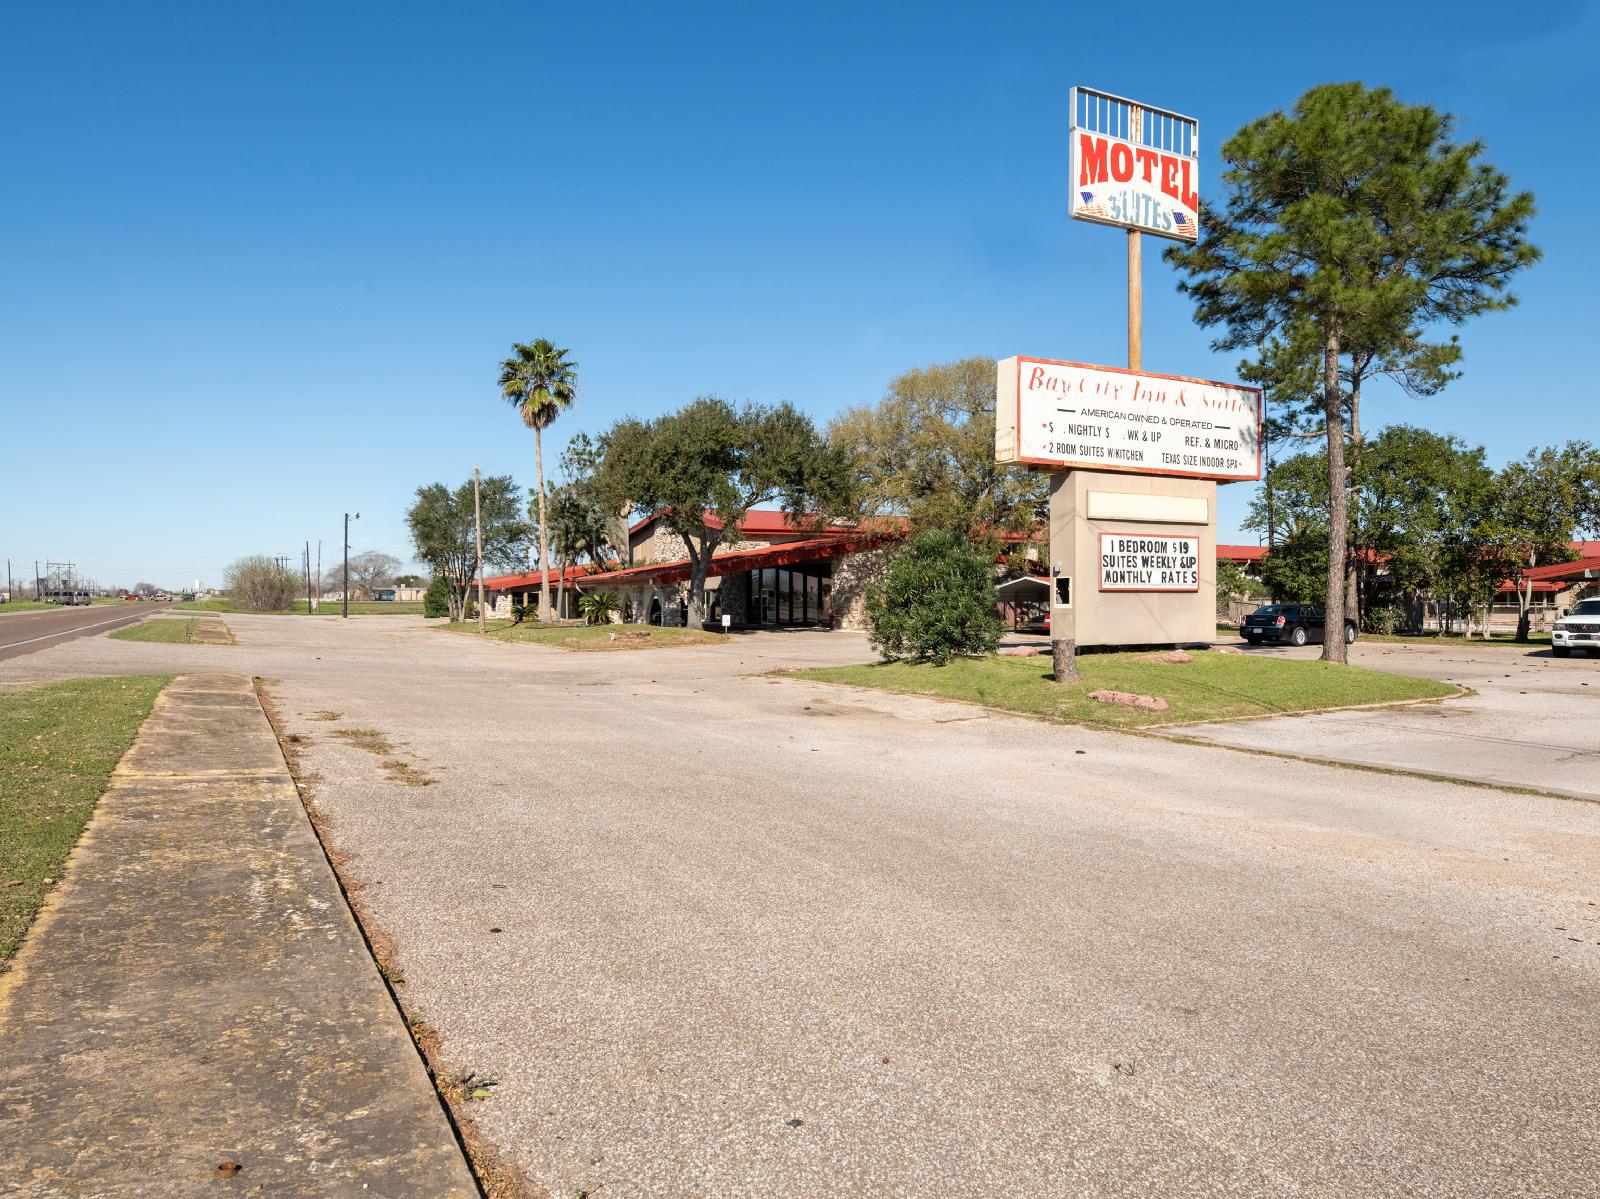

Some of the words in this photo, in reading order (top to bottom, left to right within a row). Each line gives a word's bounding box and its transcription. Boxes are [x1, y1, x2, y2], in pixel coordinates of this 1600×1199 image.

[1080, 134, 1197, 213] MOTEL
[1108, 189, 1172, 231] SUITES
[1028, 366, 1071, 400] Bay
[1080, 408, 1127, 420] AMERICAN
[1127, 413, 1160, 424] OWNED
[1161, 417, 1168, 425] &
[1169, 418, 1213, 430] OPERATED
[1068, 424, 1102, 437] NIGHTLY
[1142, 431, 1148, 442] &
[1151, 432, 1162, 443] UP
[1185, 436, 1202, 448] REF.
[1205, 438, 1211, 449] &
[1214, 438, 1239, 451] MICRO
[1049, 442, 1054, 454] 2
[1056, 443, 1077, 456] ROOM
[1079, 445, 1104, 458] SUITES
[1162, 452, 1181, 465] TEXAS
[1183, 455, 1198, 466] SIZE
[1200, 456, 1224, 468] INDOOR
[1227, 458, 1238, 469] SPA
[1119, 540, 1168, 554] BEDROOM
[1102, 555, 1138, 568] SUITES
[1141, 556, 1177, 569] WEEKLY
[1104, 570, 1153, 583] MONTHLY
[1161, 571, 1198, 583] RATES
